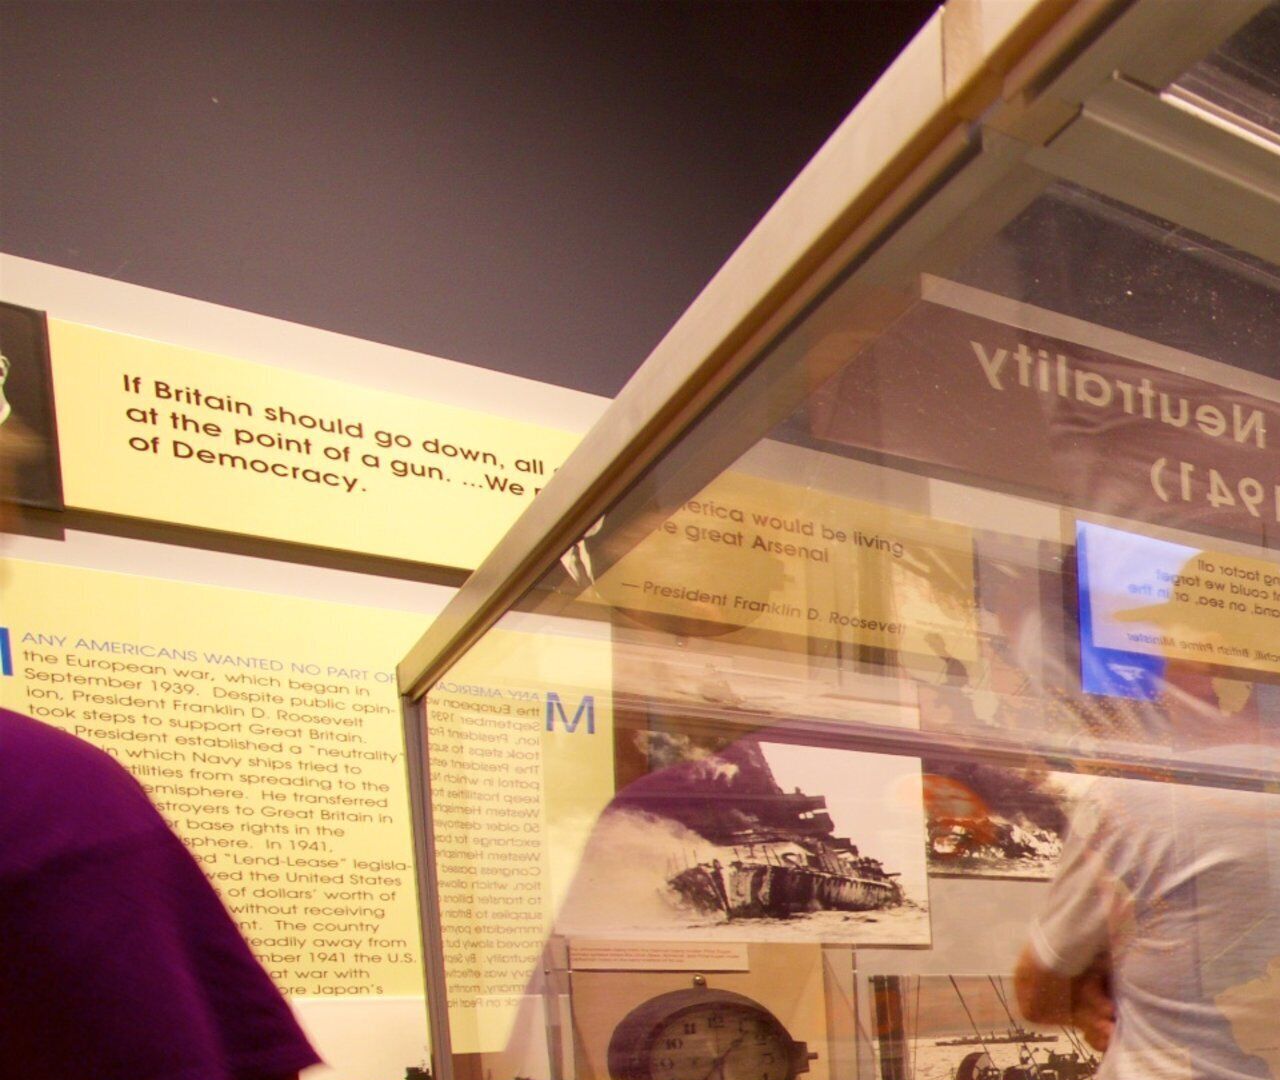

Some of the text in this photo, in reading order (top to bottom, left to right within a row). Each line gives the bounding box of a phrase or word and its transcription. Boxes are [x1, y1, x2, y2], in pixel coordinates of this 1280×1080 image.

[123, 374, 544, 475] If Britain should go down, all
[126, 408, 450, 482] at the point of a gun.
[128, 436, 366, 493] of Democracy.
[685, 523, 744, 547] great
[752, 535, 829, 563] Arsenal
[752, 512, 904, 558] would be living
[643, 580, 728, 607] President
[733, 595, 801, 618] Franklin
[807, 608, 822, 622] D.
[22, 632, 67, 647] ANY
[75, 638, 198, 662] AMERICANS
[203, 652, 284, 672] WANTED
[291, 663, 321, 676] NO
[327, 666, 368, 681] PART
[23, 650, 370, 697] the European war, which began in
[24, 668, 396, 715] September 1939. Despite public opin-
[27, 686, 364, 728] ion, President Franklin D. Roosevelt
[28, 703, 367, 745] took steps to support Great Britain.
[75, 725, 302, 756] President established a
[125, 748, 362, 775] which Navy ships tried to
[190, 767, 391, 793] from spreading to the
[261, 790, 389, 808] He transferred
[235, 805, 394, 824] to Great Britain in
[186, 818, 345, 838] base rights in the
[266, 839, 282, 850] In
[250, 871, 402, 886] the United States
[353, 859, 413, 872] legisla-
[228, 887, 396, 902] of worth of
[228, 904, 386, 919] without receiving
[275, 920, 380, 934] The country
[312, 937, 407, 950] away from
[309, 952, 417, 964] 1941 the U.S.
[271, 968, 370, 979] at war with
[312, 984, 384, 996] Japan's
